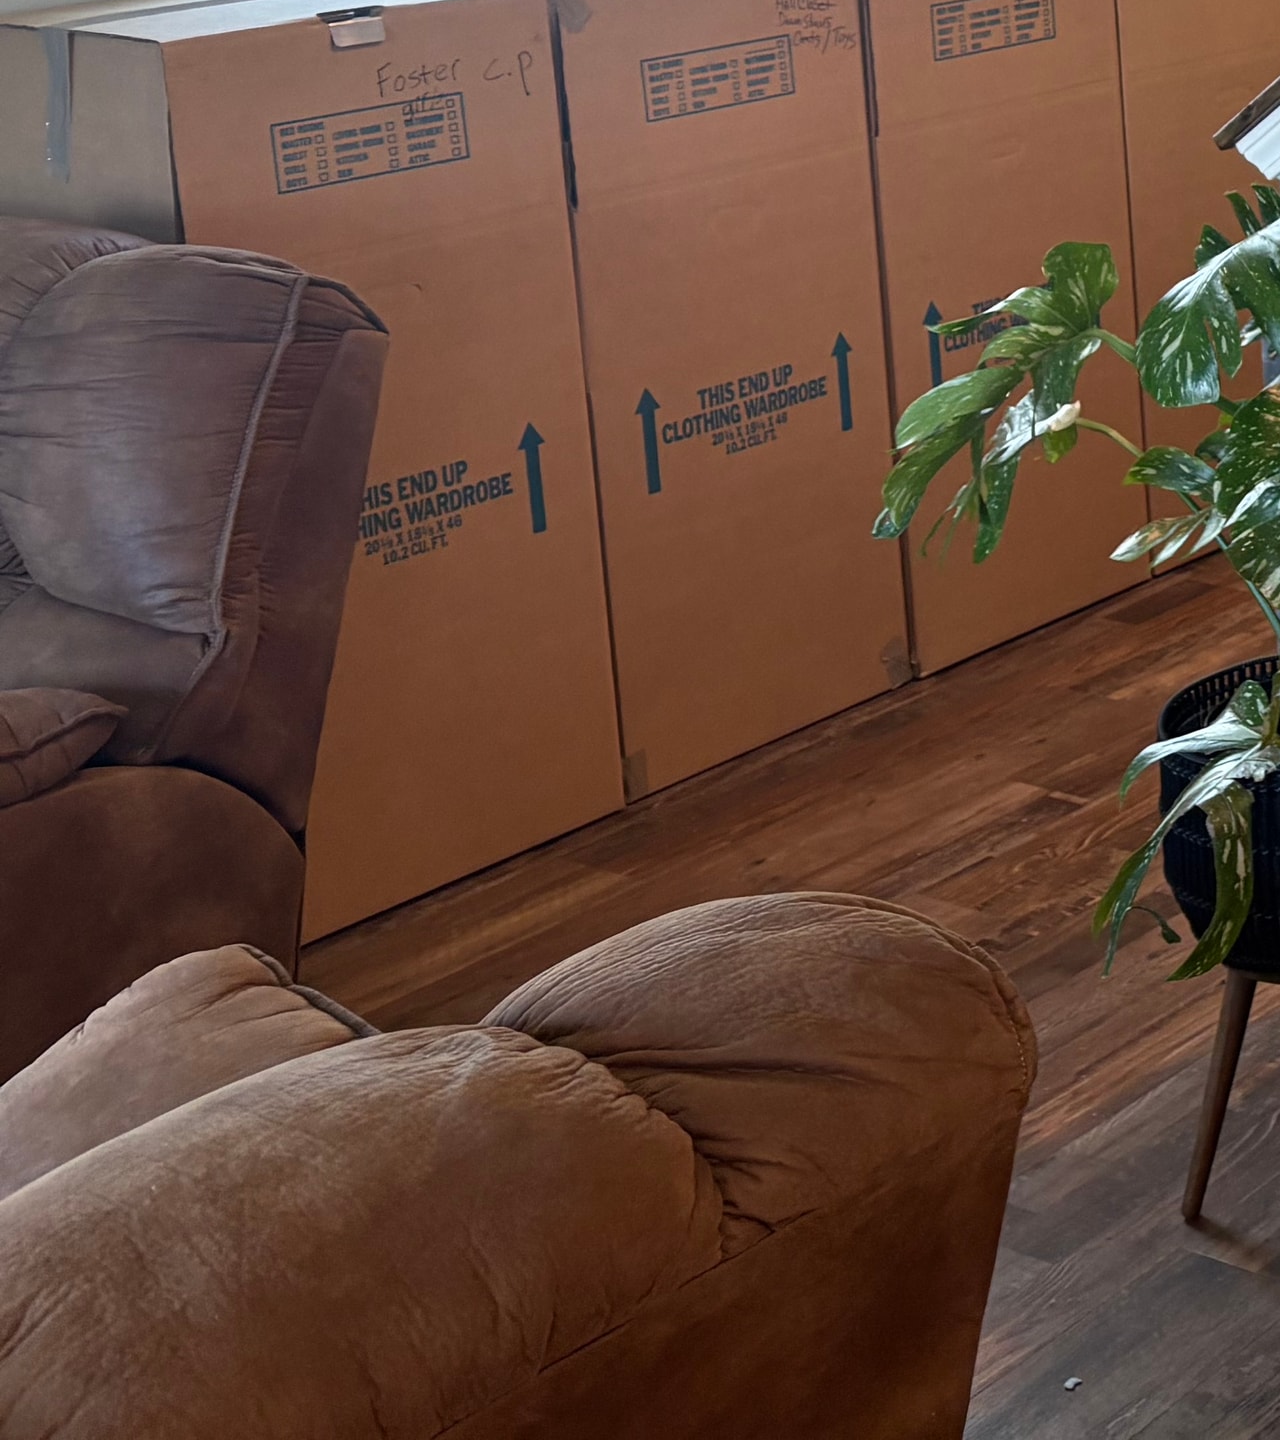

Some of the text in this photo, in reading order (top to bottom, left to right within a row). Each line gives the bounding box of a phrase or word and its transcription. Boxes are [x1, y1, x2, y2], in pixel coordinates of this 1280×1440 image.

[376, 57, 460, 98] Foster
[662, 375, 828, 445] CLOTHING WARDROBE
[697, 363, 794, 411] THIS END UP
[359, 507, 402, 540] HING
[404, 472, 514, 525] WARDROBE
[362, 460, 468, 511] HIS END UP
